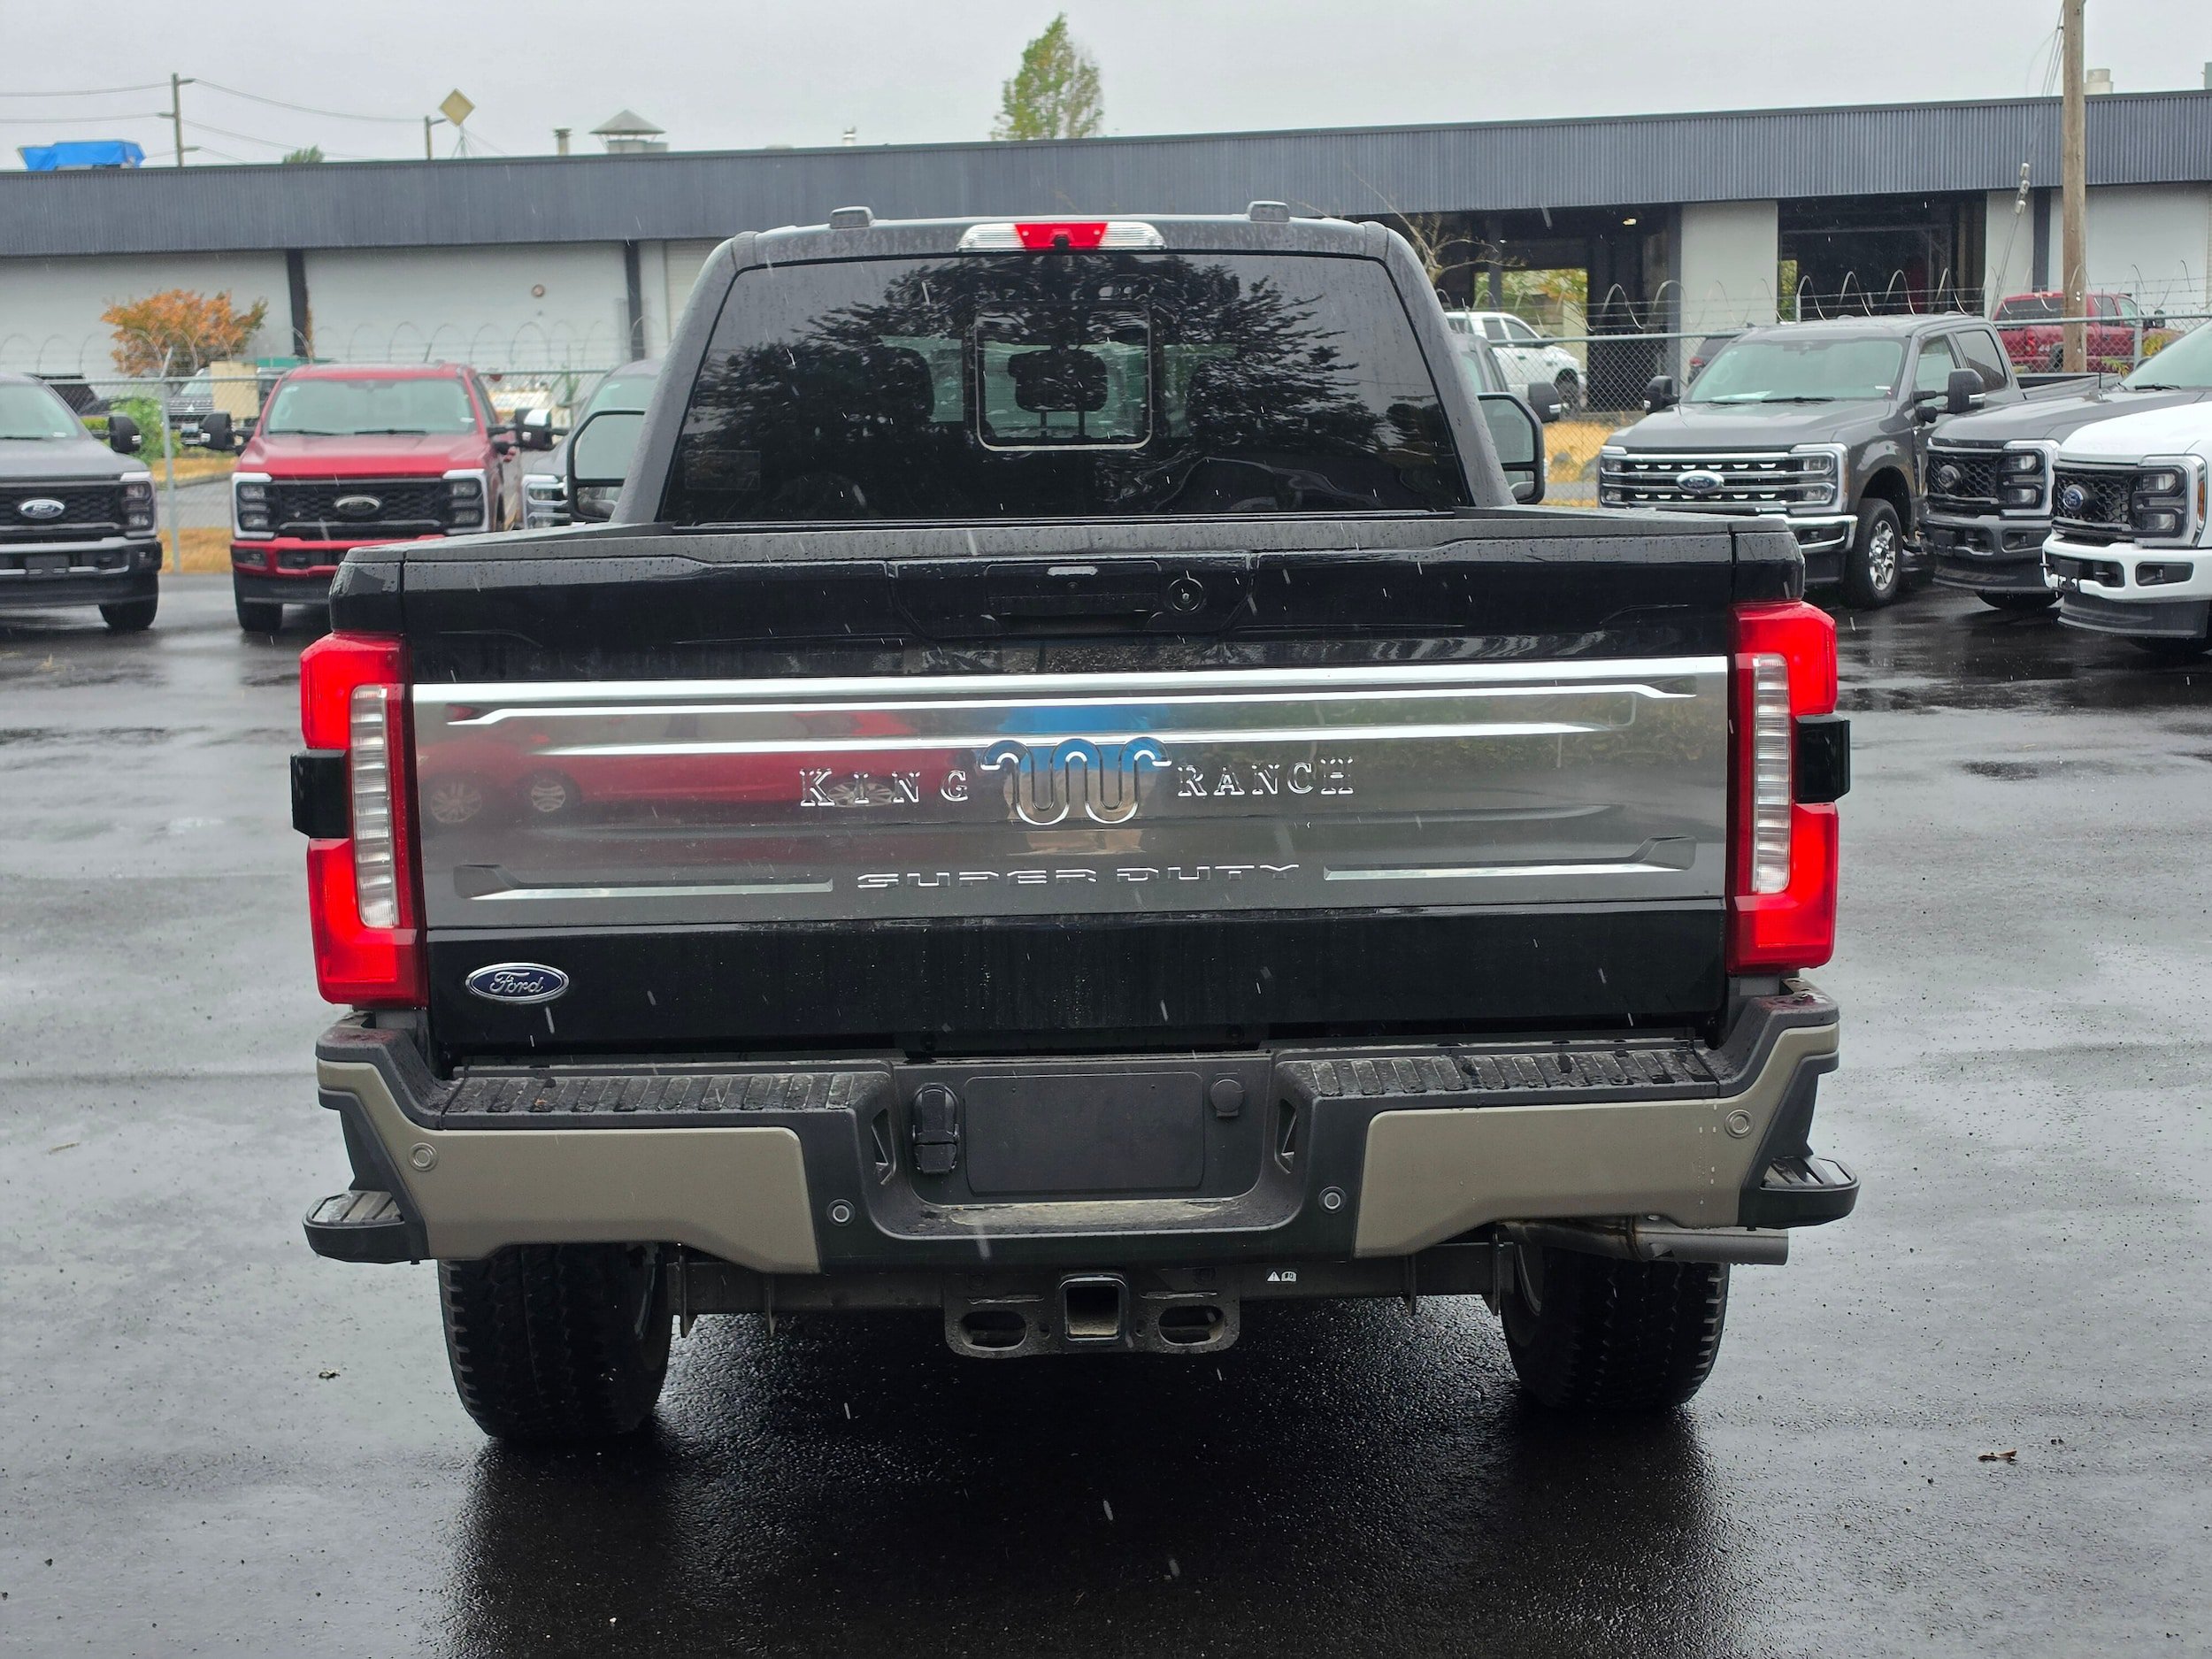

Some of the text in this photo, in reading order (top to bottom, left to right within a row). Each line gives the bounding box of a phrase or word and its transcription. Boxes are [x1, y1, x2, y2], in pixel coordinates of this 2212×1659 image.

[799, 756, 1355, 807] KING RANCH
[856, 864, 1300, 889] SUPER DUTY
[488, 971, 545, 994] Ford
